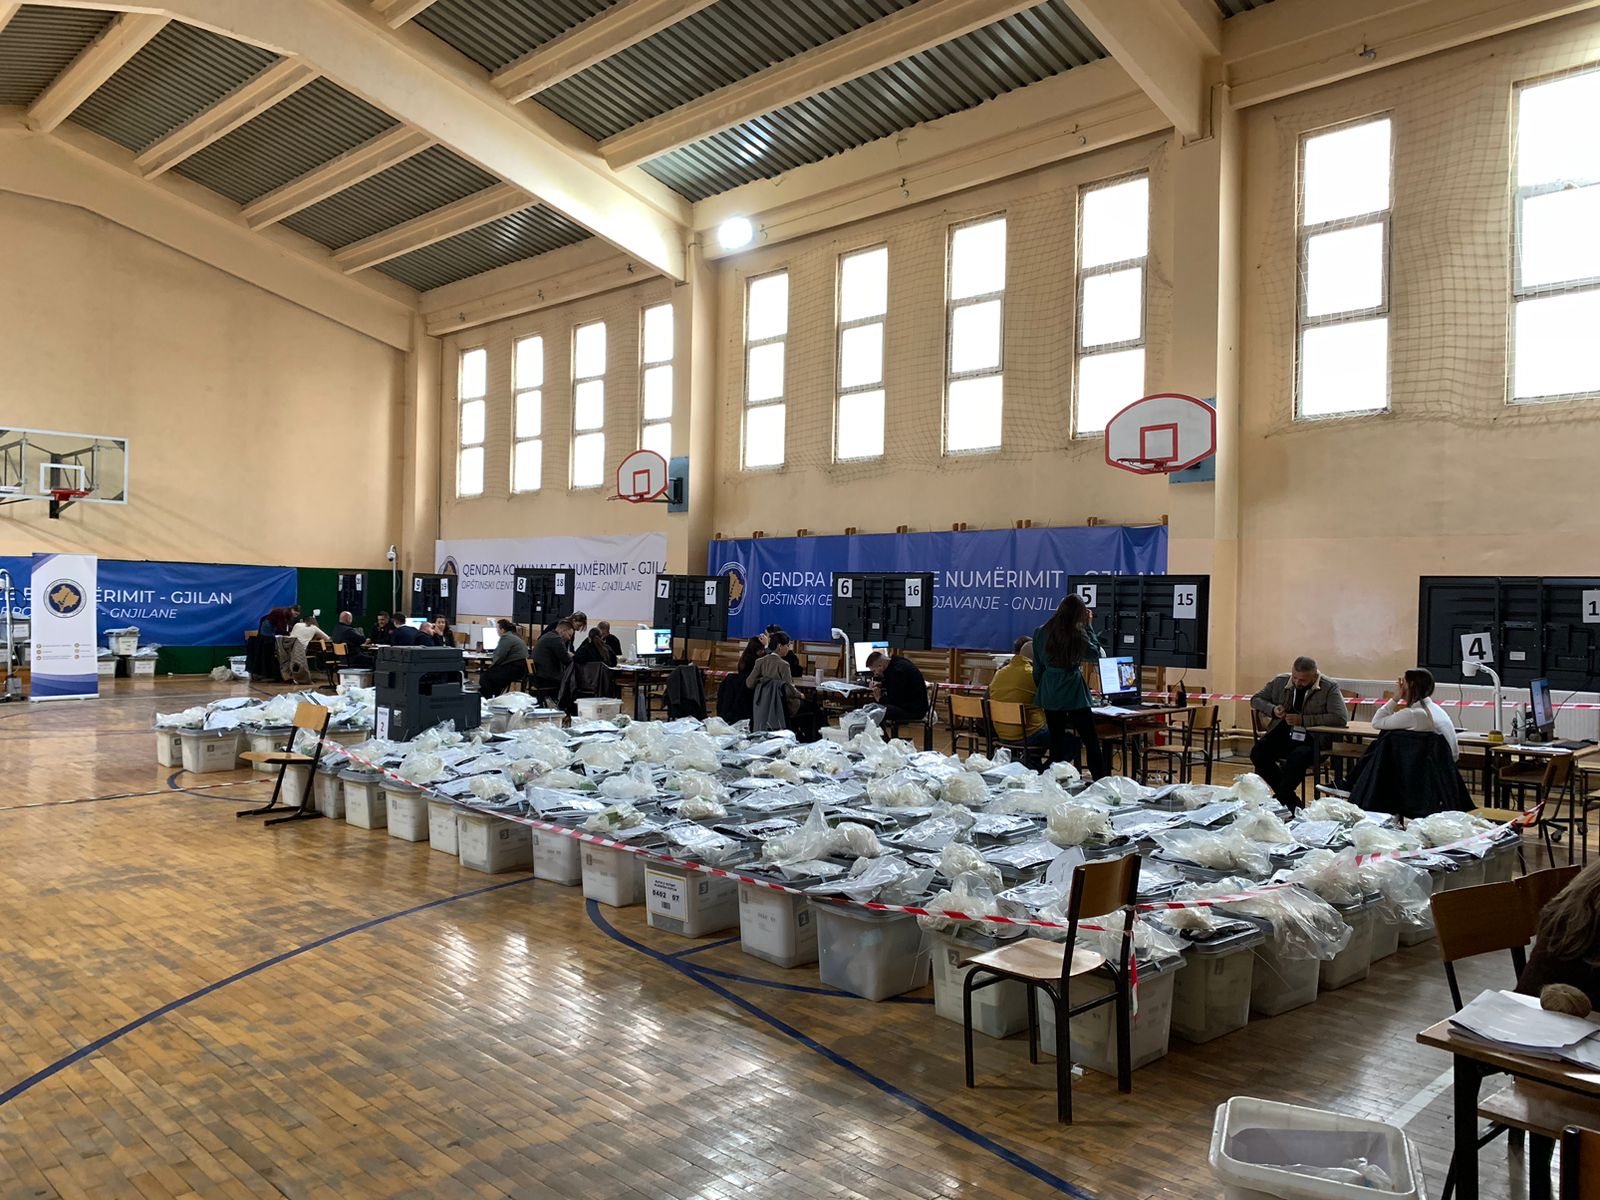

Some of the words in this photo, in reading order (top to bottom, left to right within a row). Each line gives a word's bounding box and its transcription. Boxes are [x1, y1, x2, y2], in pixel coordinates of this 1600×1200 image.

[462, 563, 501, 577] QENDRA
[518, 578, 524, 591] 8
[556, 578, 564, 587] 18
[762, 571, 826, 589] QENDRA
[945, 566, 1064, 589] NUMËRIMIT
[495, 580, 514, 590] CENT
[660, 583, 667, 597] 7
[706, 586, 715, 596] 17
[841, 580, 850, 595] 6
[907, 585, 920, 596] 16
[170, 591, 232, 604] GJILAN
[760, 591, 816, 606] OPŠTINSKI
[1082, 587, 1092, 604] 5
[1177, 593, 1194, 606] 15
[110, 608, 178, 619] GNJILANE
[1588, 600, 1600, 617] 1
[1468, 636, 1487, 660] 4
